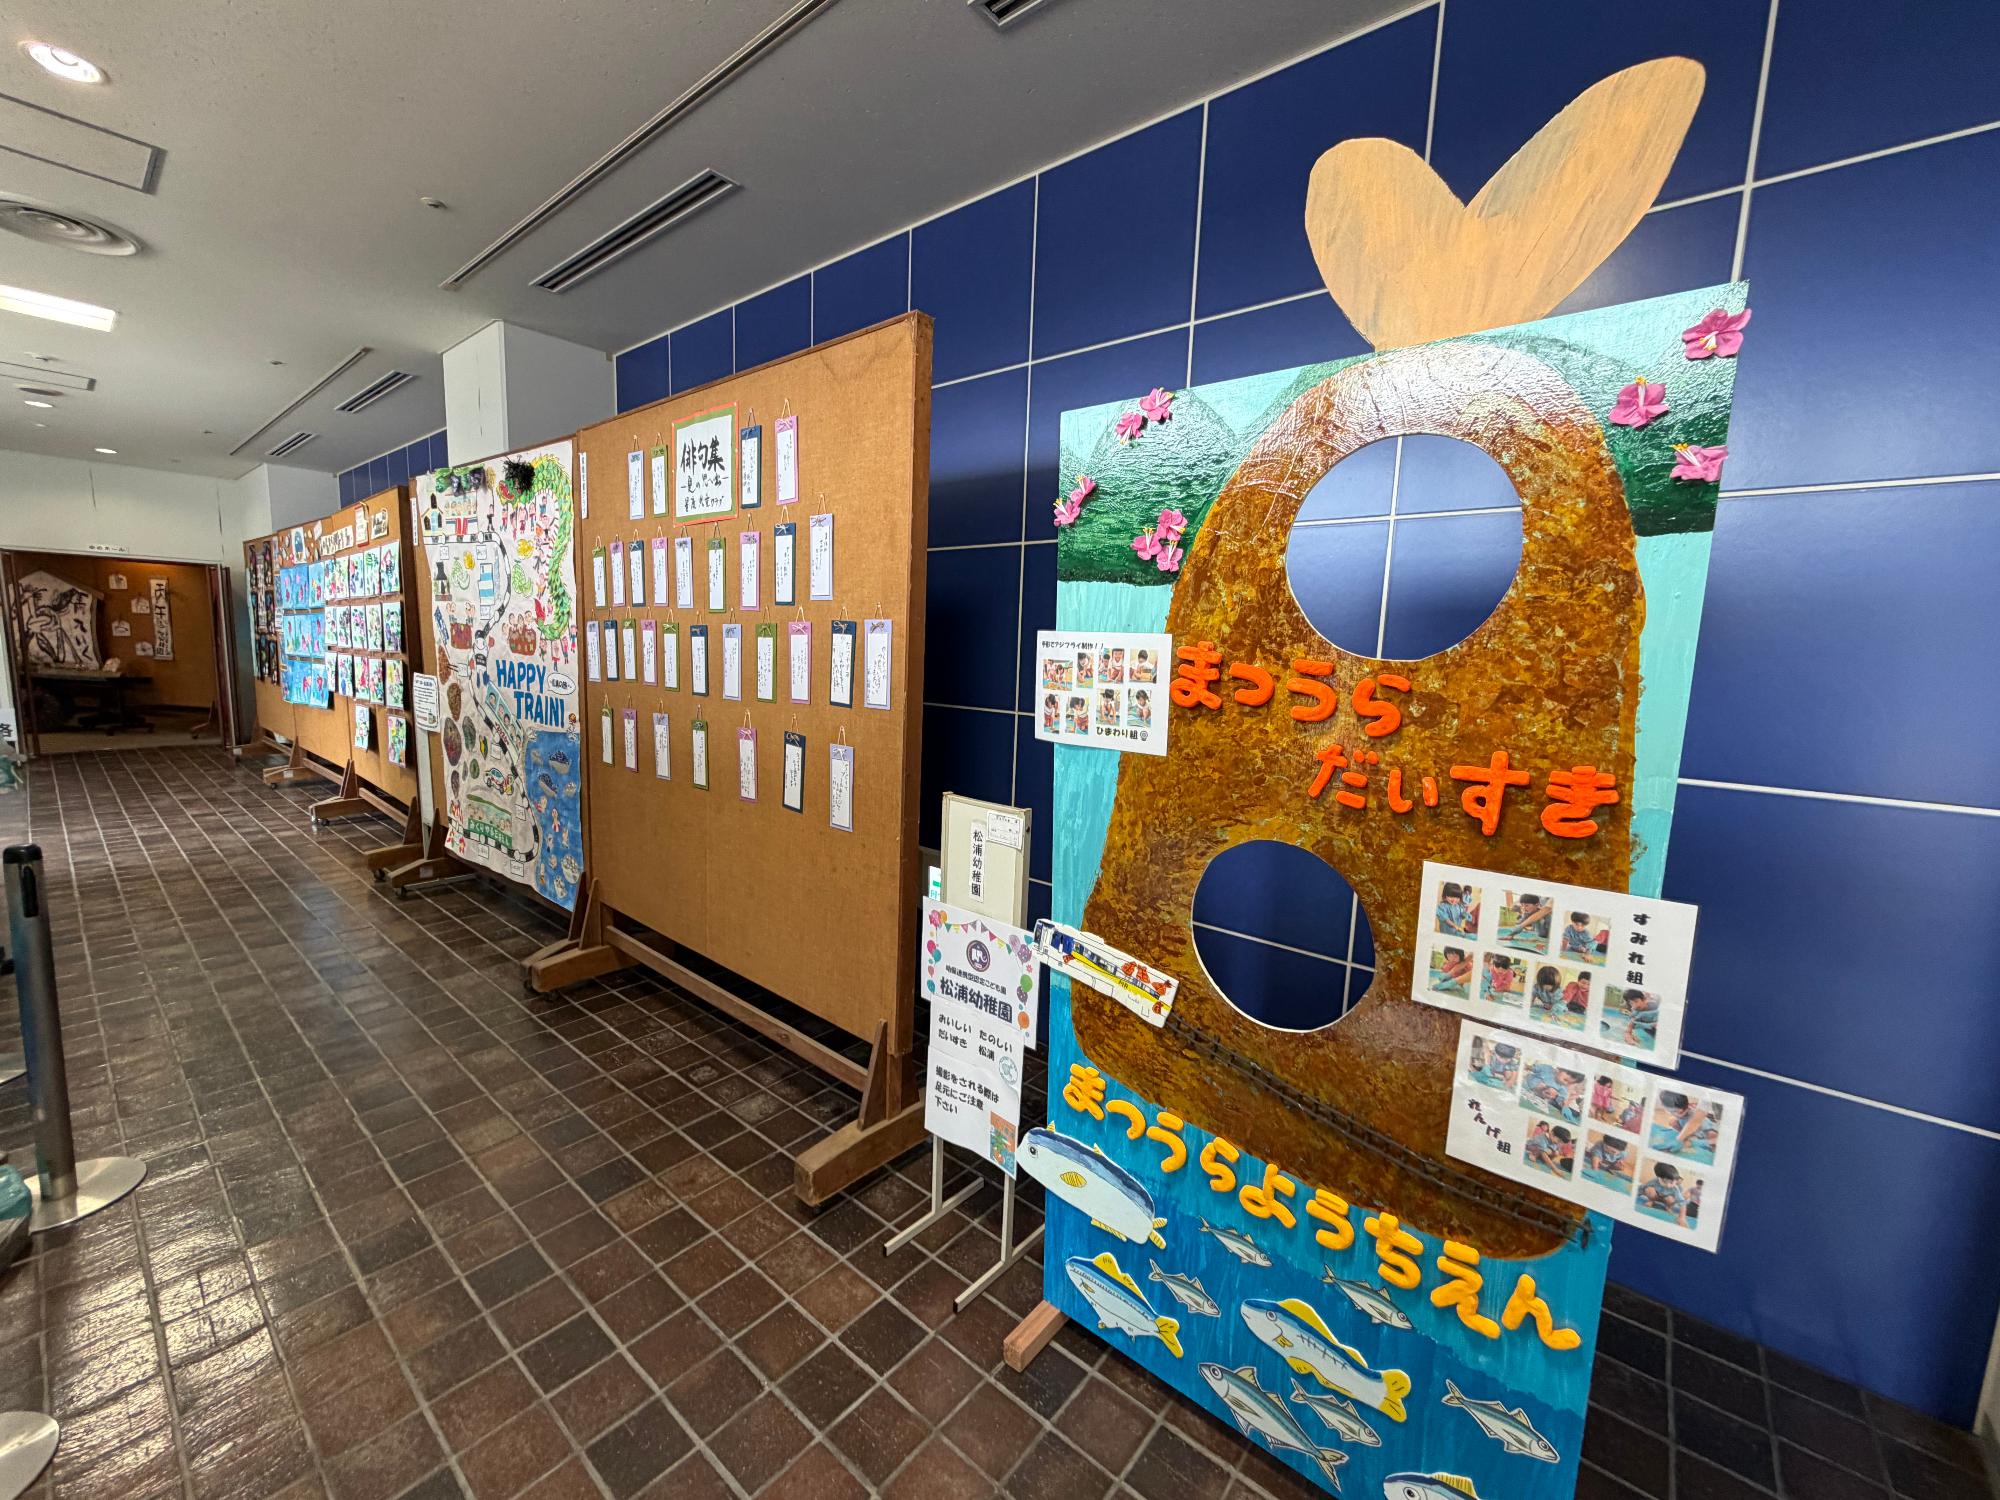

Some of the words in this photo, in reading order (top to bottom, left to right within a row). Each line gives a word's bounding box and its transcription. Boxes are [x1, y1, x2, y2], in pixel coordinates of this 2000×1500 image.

[680, 434, 726, 476] 俳句集
[496, 660, 546, 695] HAPPY
[1170, 641, 1412, 738] まつうら
[514, 691, 565, 728] TRAIN!
[1096, 726, 1138, 740] ひまわり組
[1307, 743, 1620, 838] だいすき
[971, 829, 984, 897] 松浦幼稚園
[1626, 913, 1652, 985] すみれ組
[940, 976, 1012, 1024] 松浦幼稚園
[938, 1014, 972, 1034] おいしい
[979, 1030, 1012, 1053] たのしい
[938, 1028, 968, 1049] だいすき
[978, 1044, 995, 1062] 松浦
[934, 1081, 984, 1111] 足元にご注意
[935, 1065, 1000, 1104] 撮影をされる際は
[934, 1095, 958, 1115] 下さい
[1467, 1099, 1511, 1155] れんげ組
[1063, 1063, 1581, 1350] まつうらようちえん
